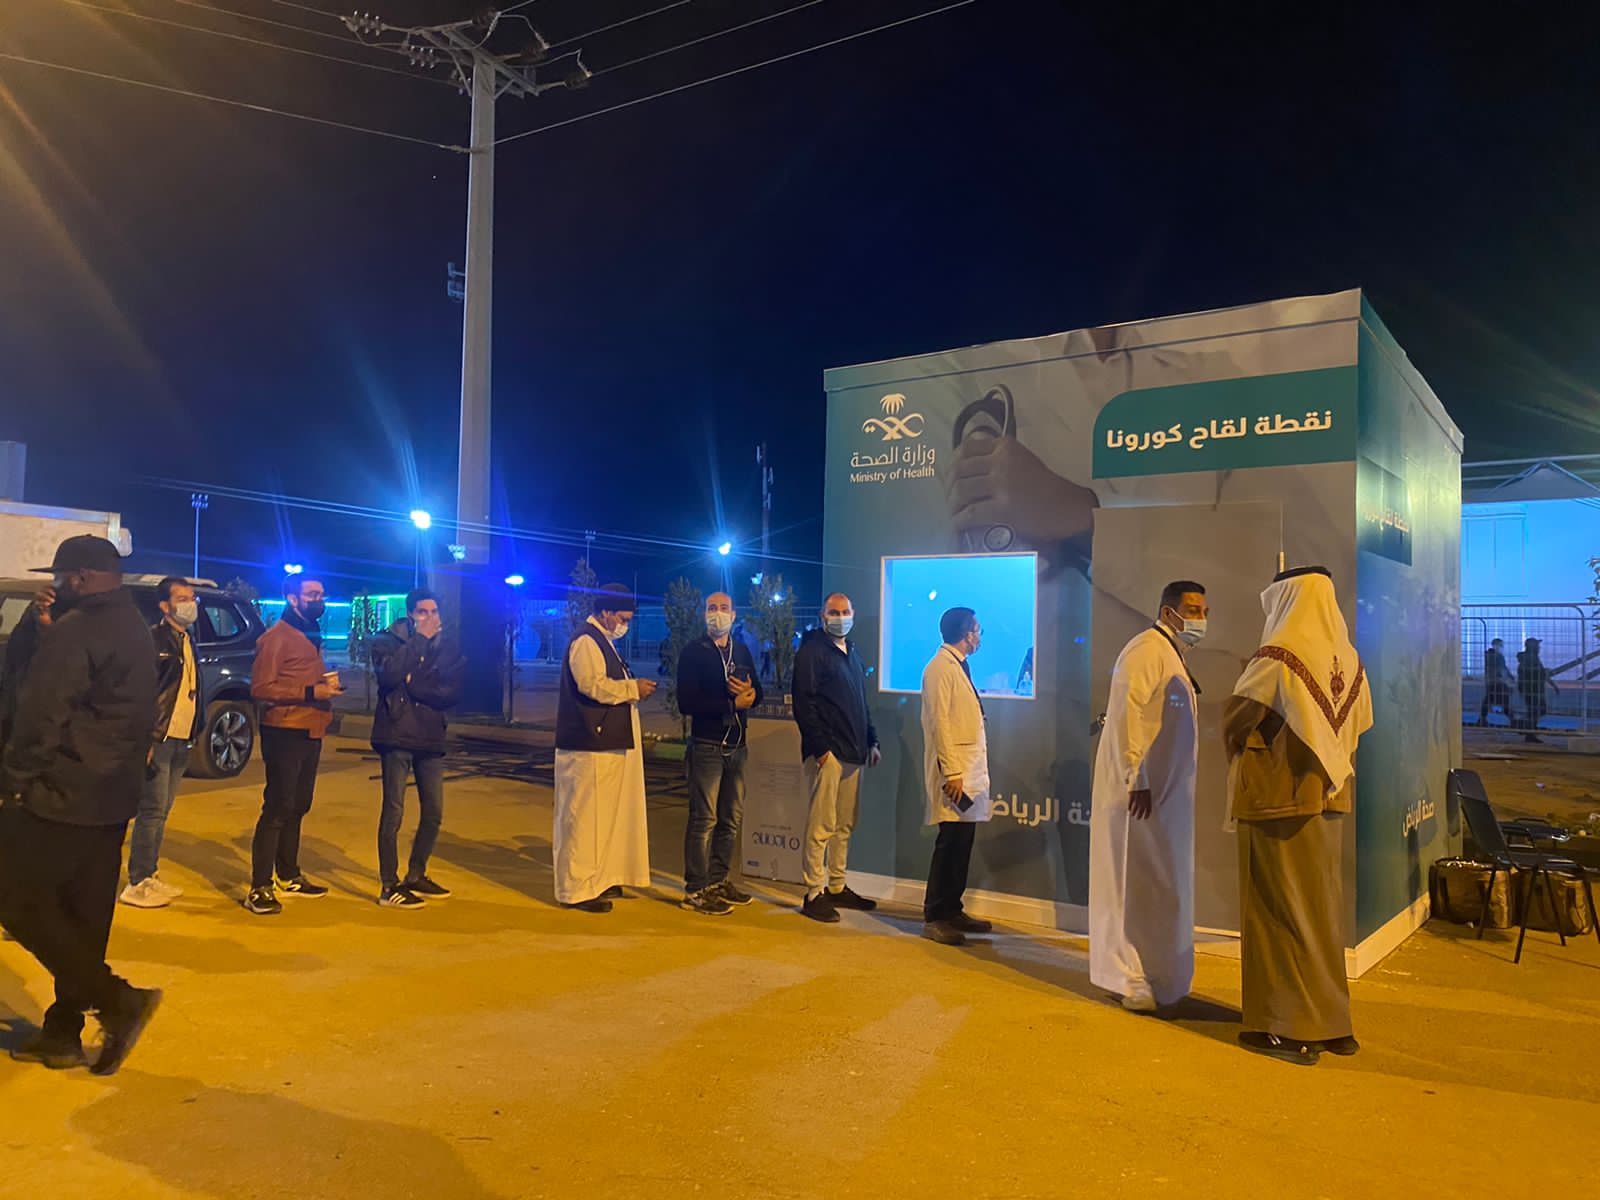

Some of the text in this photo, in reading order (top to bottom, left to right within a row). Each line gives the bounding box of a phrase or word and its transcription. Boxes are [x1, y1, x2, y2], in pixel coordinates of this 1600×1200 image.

[1105, 409, 1333, 452] نقطة لقاح كورونا
[850, 444, 936, 468] وزارة الصحة
[850, 465, 935, 484] Ministry of Health
